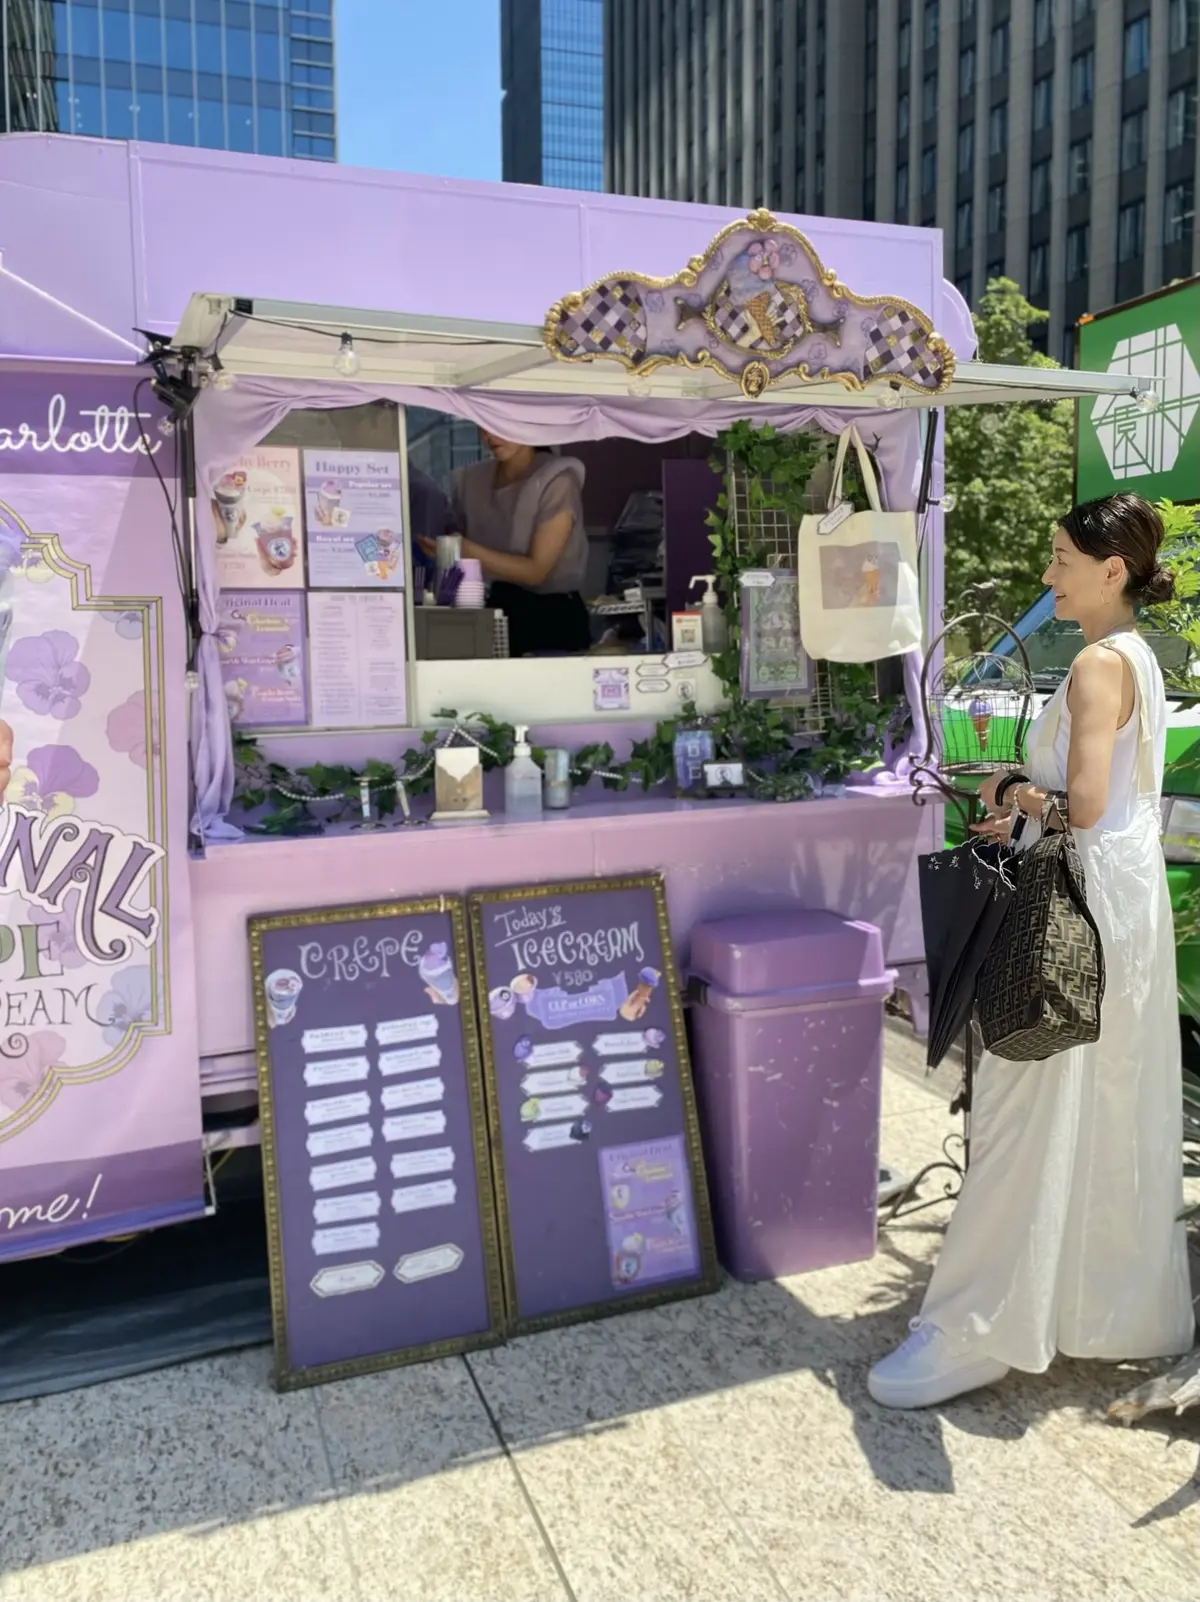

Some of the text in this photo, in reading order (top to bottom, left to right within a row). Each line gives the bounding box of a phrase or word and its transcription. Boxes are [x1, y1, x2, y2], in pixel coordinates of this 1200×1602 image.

[315, 461, 389, 475] Happy Set
[297, 929, 422, 981] CREPE
[0, 982, 116, 1028] EAM
